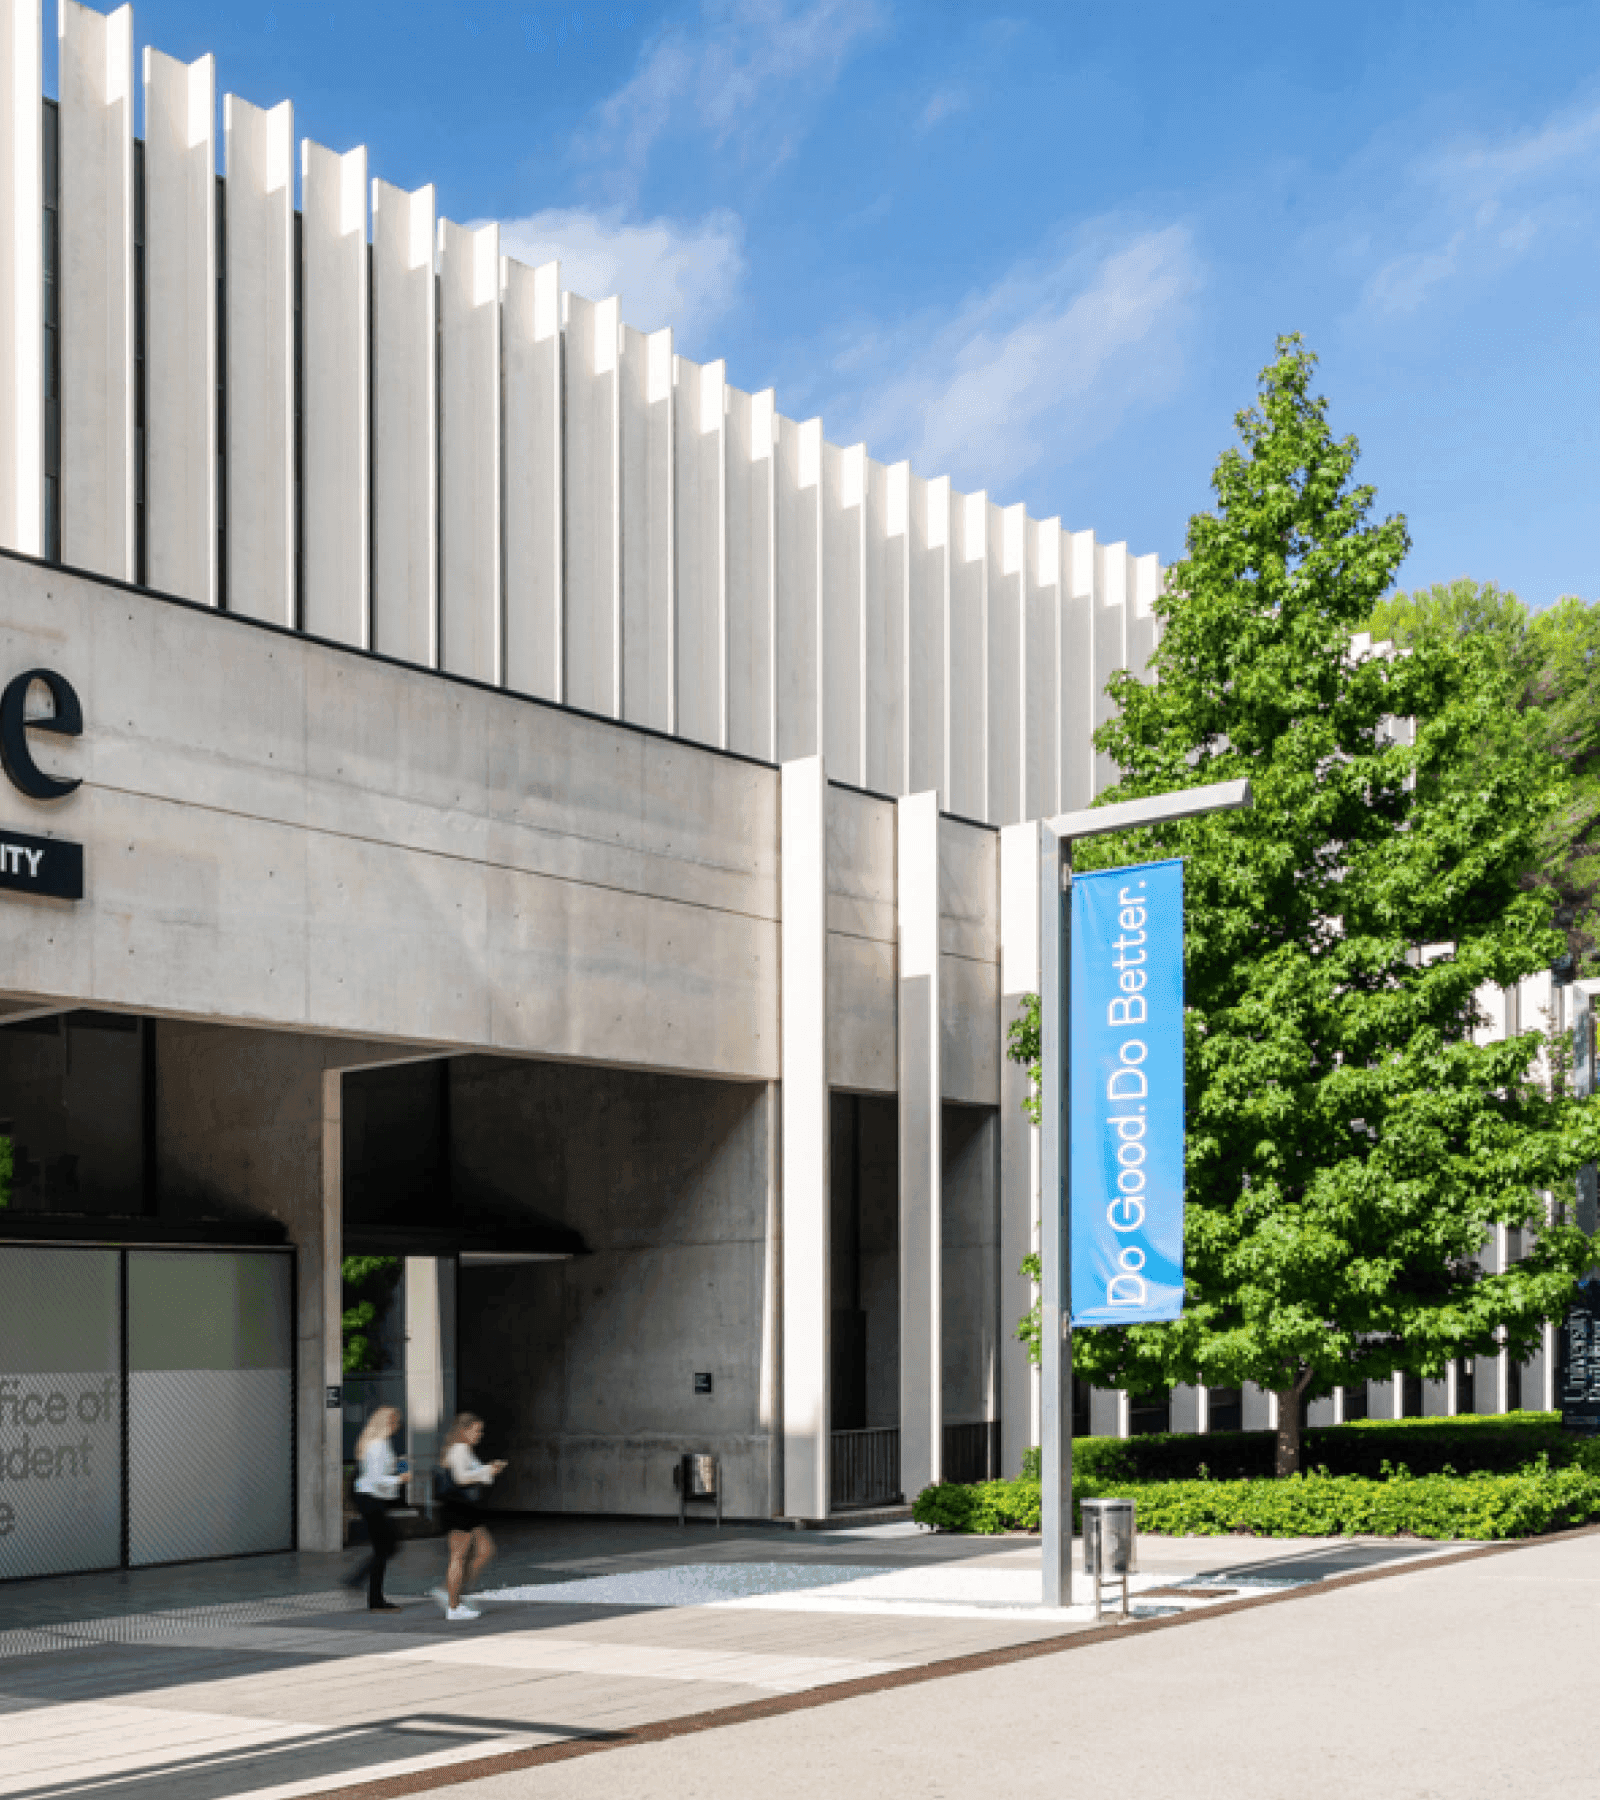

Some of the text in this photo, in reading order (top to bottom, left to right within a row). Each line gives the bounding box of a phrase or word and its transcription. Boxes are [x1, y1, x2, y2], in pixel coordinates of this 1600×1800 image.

[1108, 879, 1148, 1027] Better.
[1107, 1245, 1148, 1306] Do
[75, 1376, 116, 1424] of
